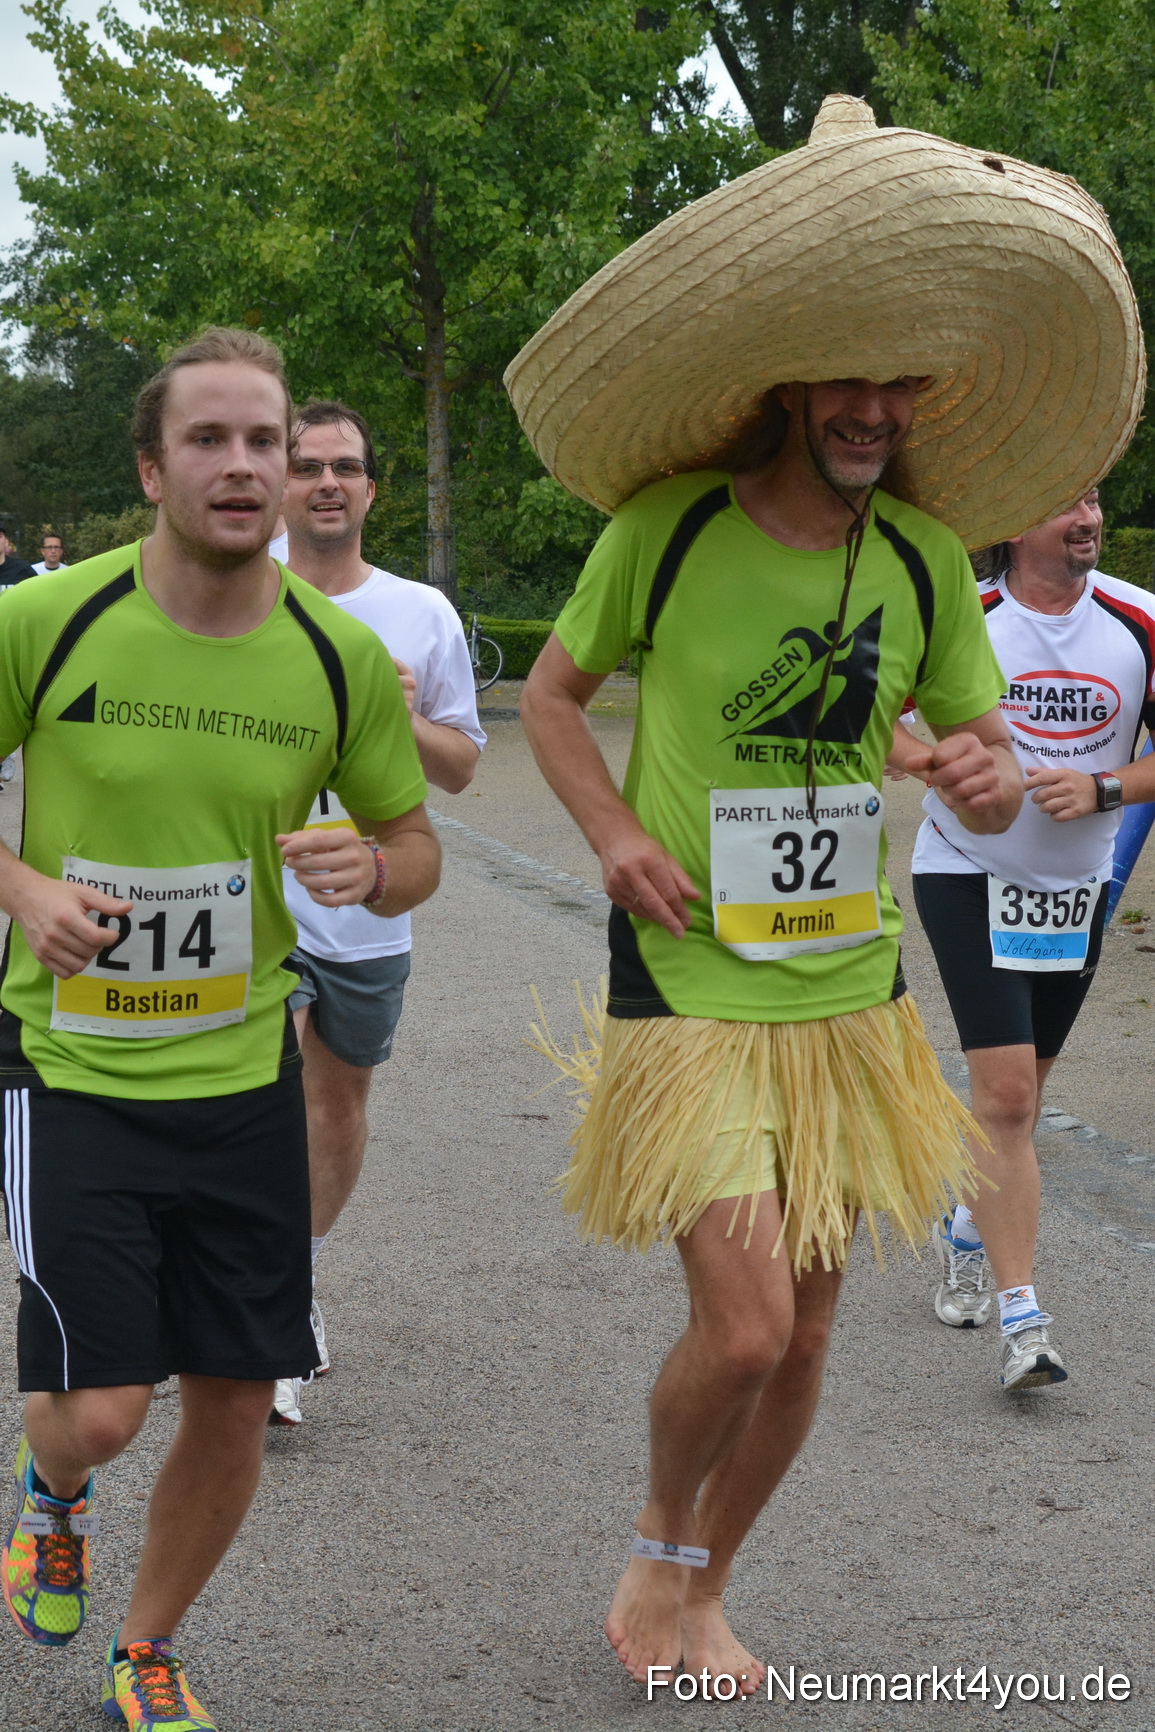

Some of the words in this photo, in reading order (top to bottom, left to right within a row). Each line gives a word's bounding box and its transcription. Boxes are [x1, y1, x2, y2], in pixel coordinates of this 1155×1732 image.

[721, 646, 804, 722] GOSSEN
[1095, 692, 1105, 702] &
[100, 700, 190, 730] GOSSEN
[196, 708, 321, 752] METRAWATT
[1017, 740, 1070, 758] sportliche
[1073, 730, 1116, 757] Autohaus
[715, 807, 778, 822] PARTL
[782, 803, 860, 822] Neumarkt
[772, 829, 839, 893] 32
[129, 883, 220, 901] Neumarkt
[719, 891, 727, 902] D
[1001, 885, 1091, 928] 3356
[771, 909, 835, 935] Armin
[96, 909, 216, 971] 214
[999, 936, 1064, 961] Wolfgang
[105, 988, 199, 1014] Bastian
